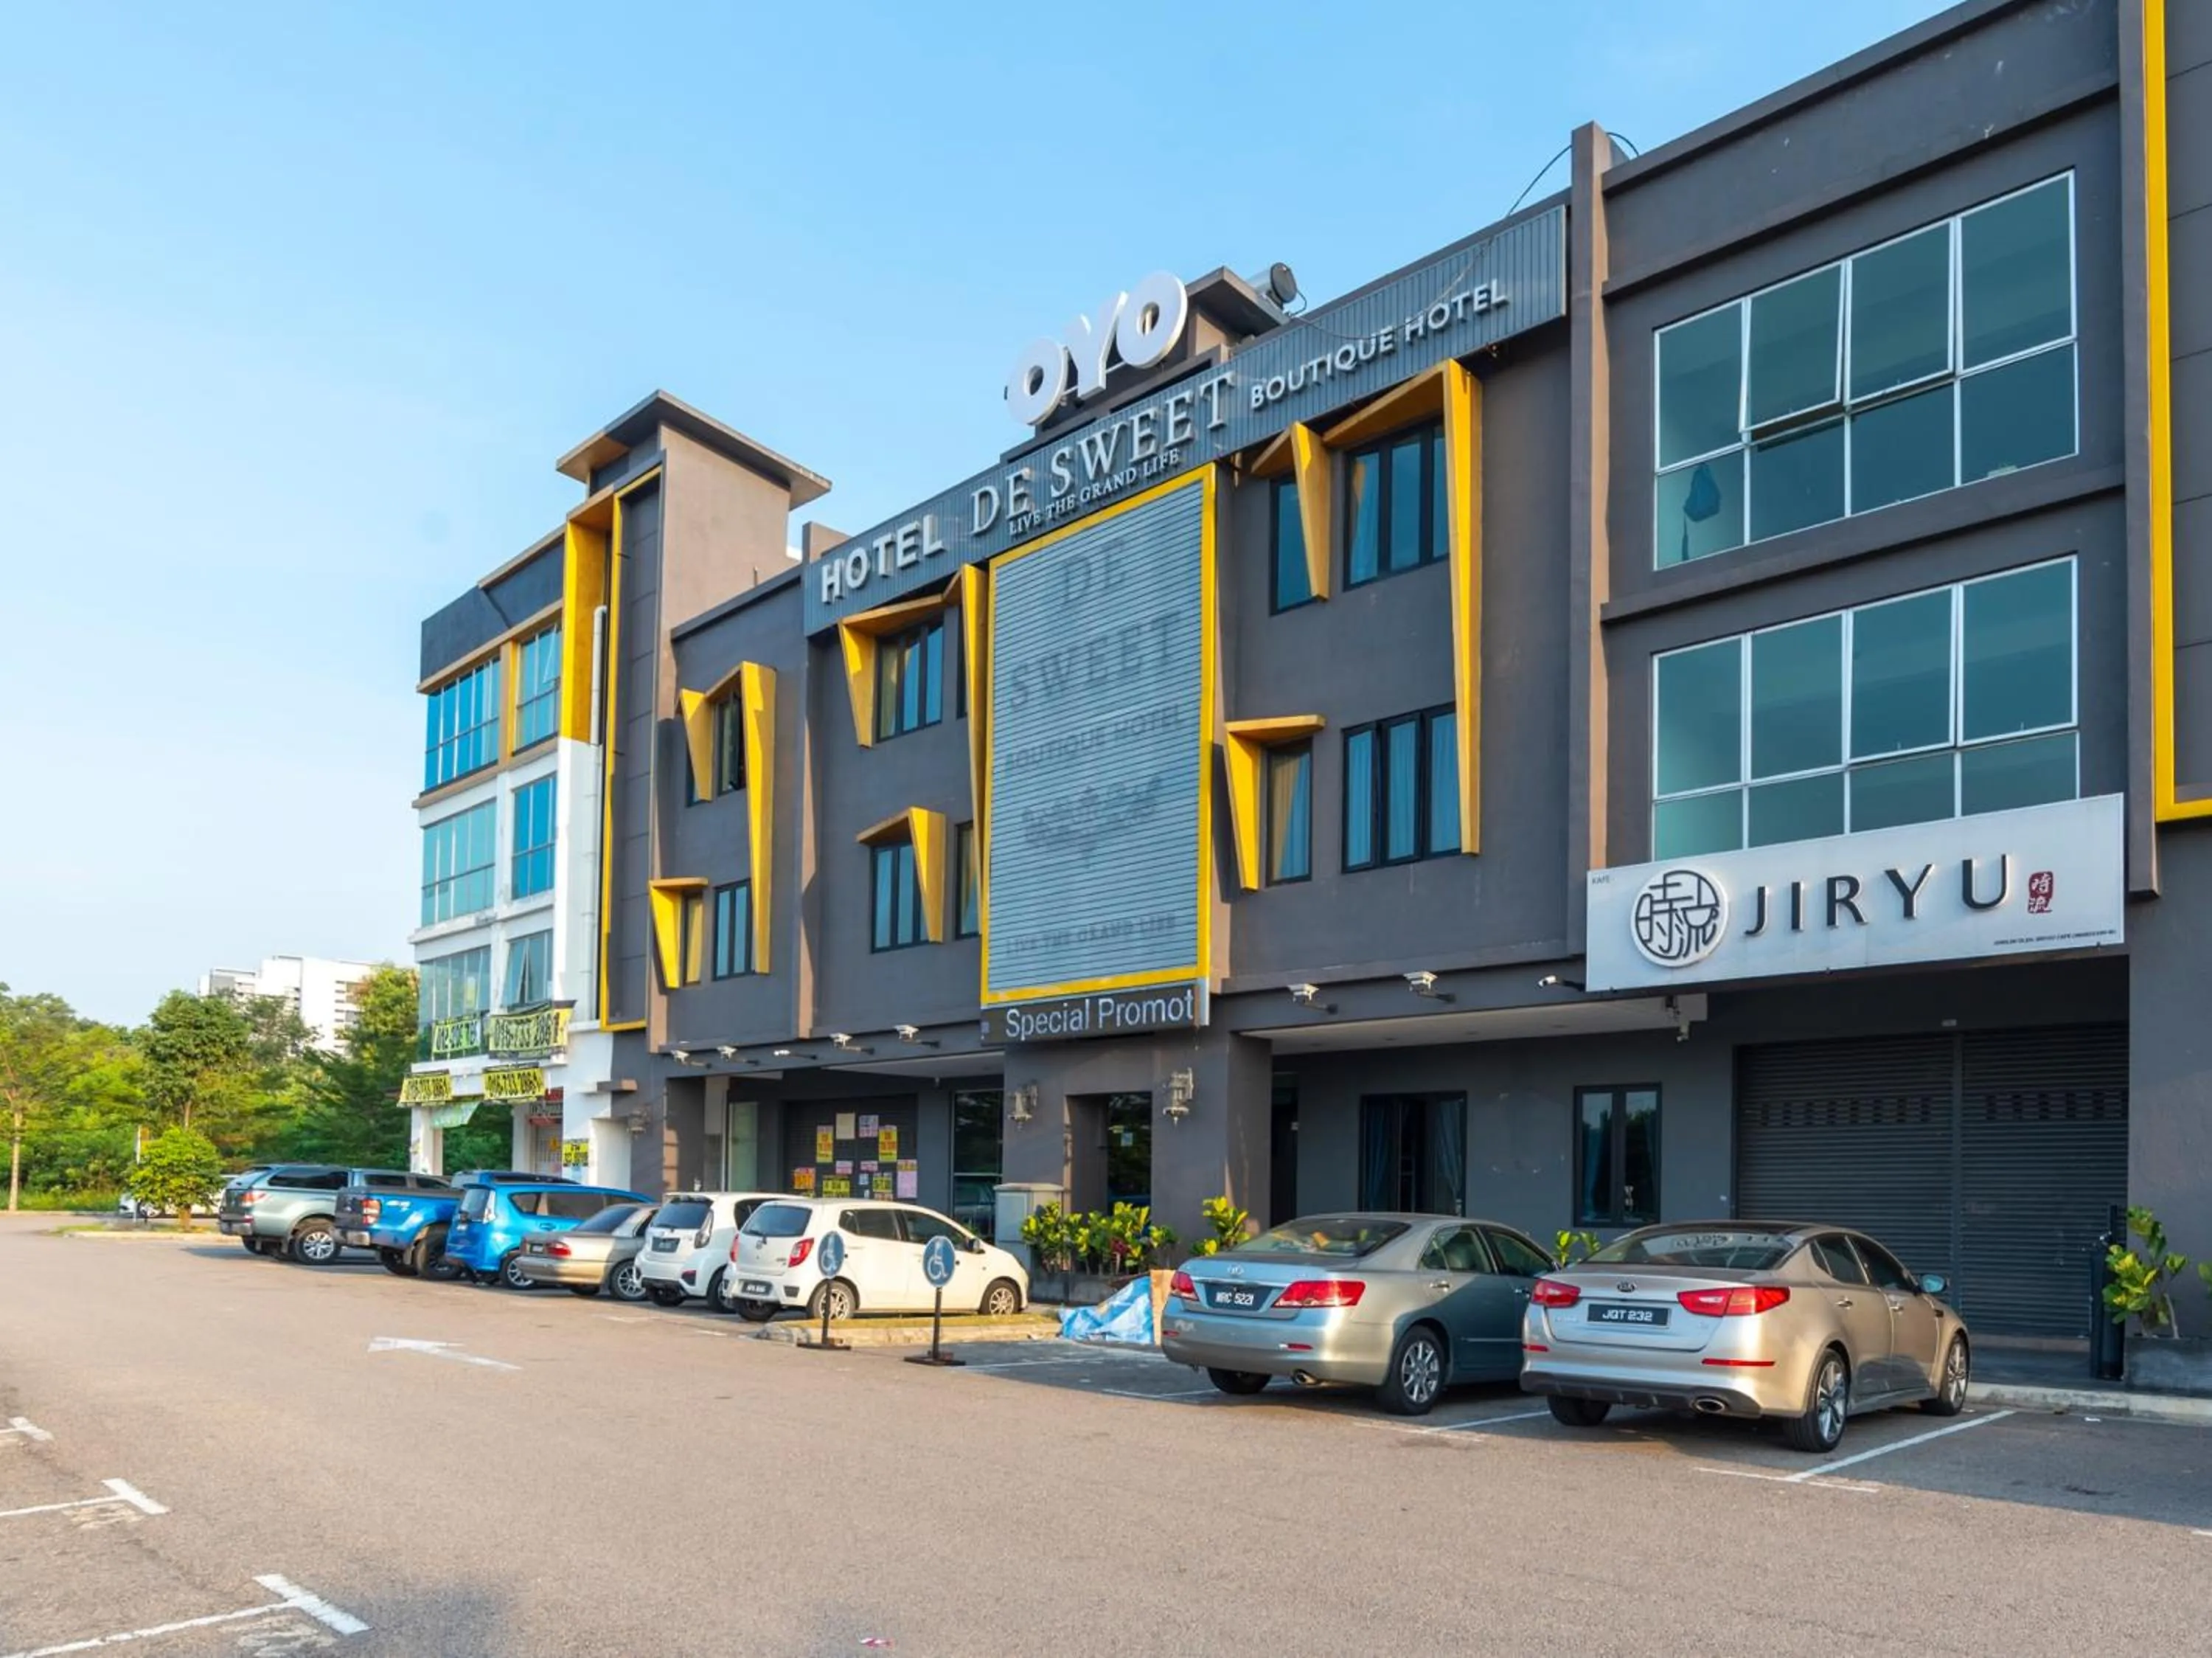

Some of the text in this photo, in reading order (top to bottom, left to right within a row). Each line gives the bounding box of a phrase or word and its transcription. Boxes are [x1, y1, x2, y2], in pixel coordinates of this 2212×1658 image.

[1004, 270, 1188, 425] OYO
[821, 279, 1509, 606] HOTEL DE SWEET BOUTIQUE HOTEL
[1009, 447, 1180, 537] LIVE THE GRAND LIFE
[1010, 611, 1181, 712] SWEET
[1744, 854, 2009, 937] JIRYU
[1005, 998, 1091, 1041] Special
[1627, 1310, 1653, 1322] 232
